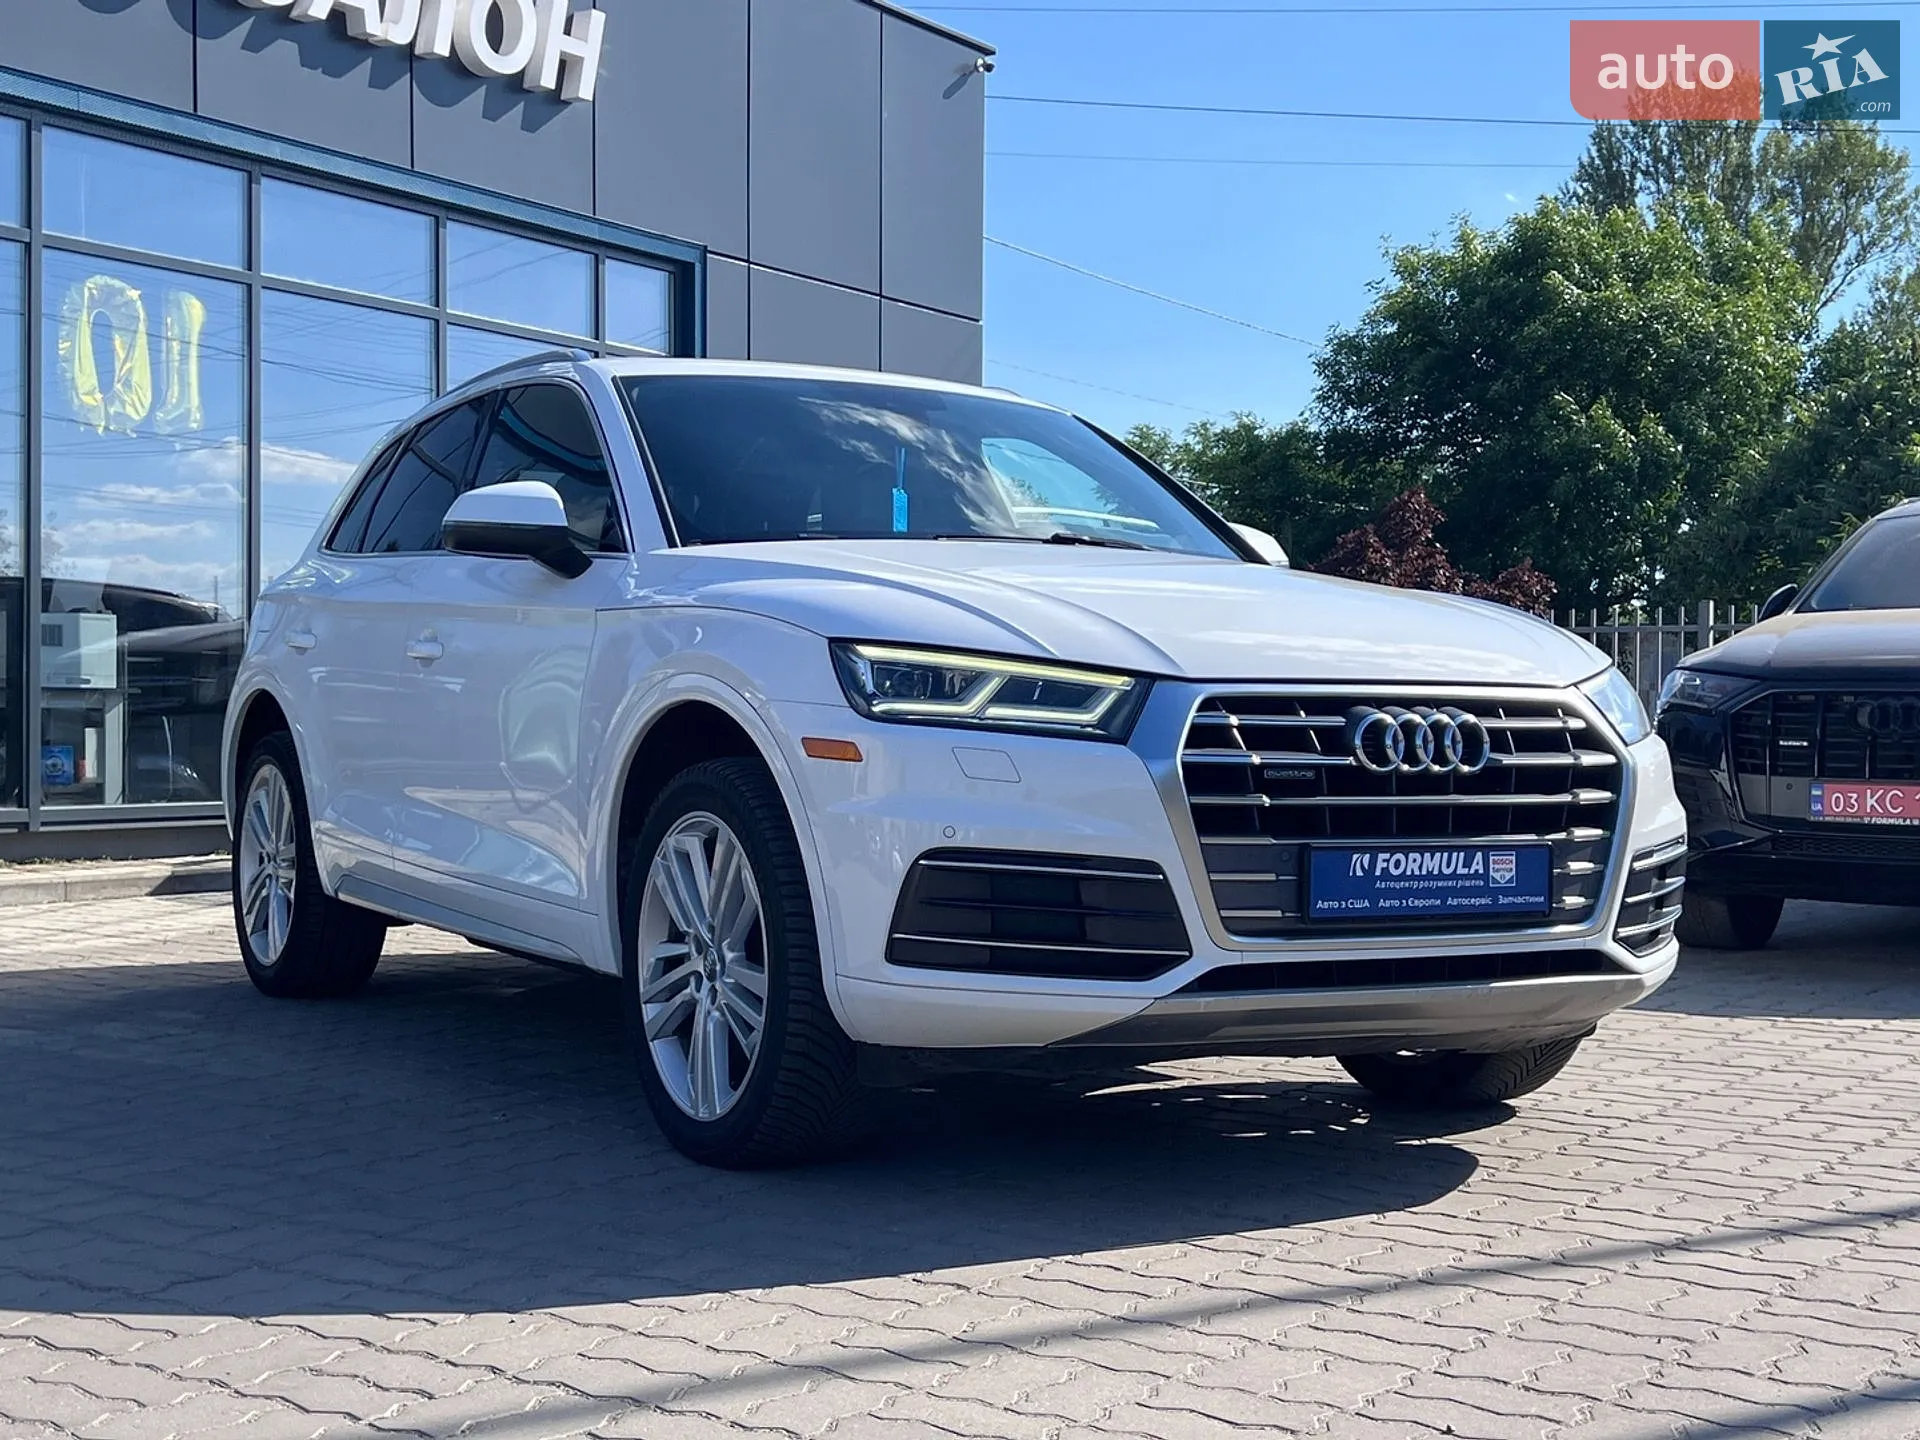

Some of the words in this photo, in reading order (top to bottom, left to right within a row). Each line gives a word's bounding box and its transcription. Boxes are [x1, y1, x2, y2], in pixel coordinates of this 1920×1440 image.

[1811, 802, 1823, 811] UA
[1831, 792, 1859, 813] 03
[1866, 789, 1904, 814] KC
[1871, 817, 1911, 825] FORMULA
[1374, 851, 1485, 876] FORMULA
[1316, 900, 1339, 909] Авто
[1347, 899, 1370, 908] США
[1378, 898, 1400, 908] Авто
[1408, 897, 1441, 908] Європи
[1446, 896, 1492, 906] Автосервіс
